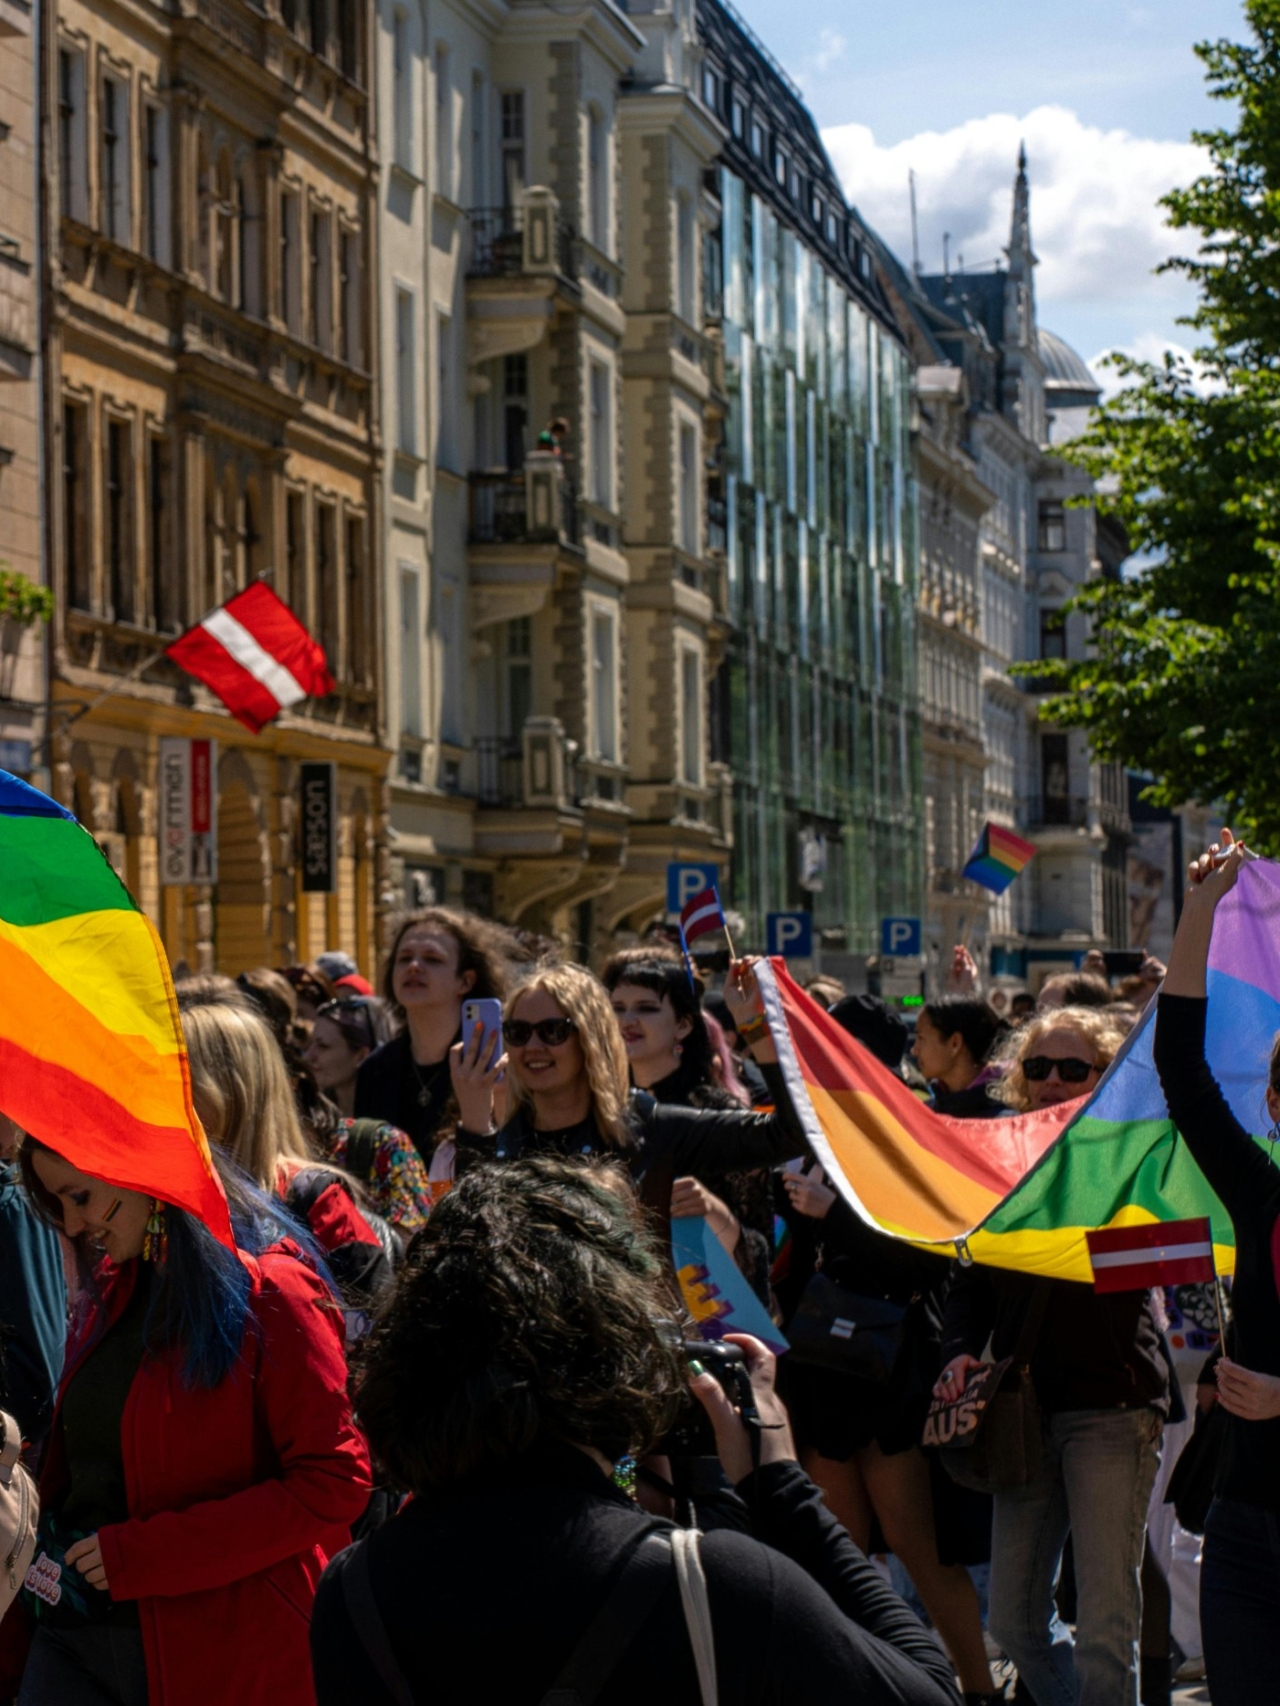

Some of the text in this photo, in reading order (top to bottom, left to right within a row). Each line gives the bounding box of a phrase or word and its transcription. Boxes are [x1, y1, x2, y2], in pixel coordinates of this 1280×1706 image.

[679, 869, 707, 908] P
[776, 917, 802, 953] P
[890, 922, 912, 952] P
[37, 1554, 59, 1579] love
[27, 1567, 59, 1600] is love
